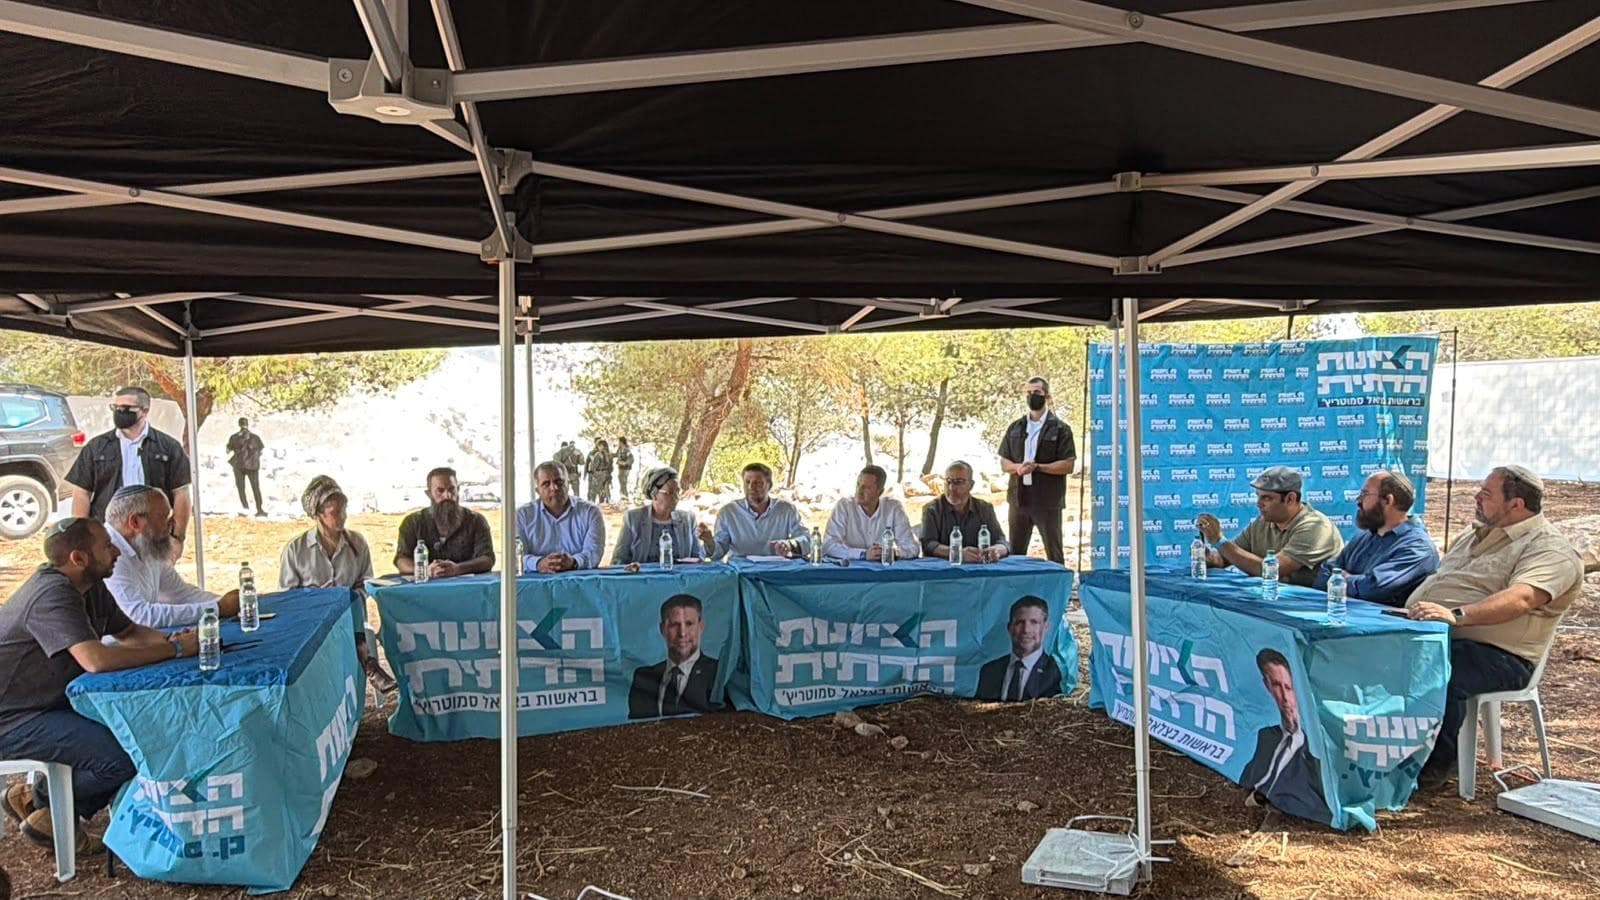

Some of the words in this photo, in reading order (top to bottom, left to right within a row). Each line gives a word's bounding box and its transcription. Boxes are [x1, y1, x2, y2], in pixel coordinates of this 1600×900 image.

[1317, 373, 1427, 395] הדתית
[775, 617, 957, 648] הציונות
[775, 651, 956, 684] הדתית
[536, 689, 598, 706] בראשות
[782, 688, 836, 706] סמוטריץ'
[1177, 734, 1226, 760] בראשות
